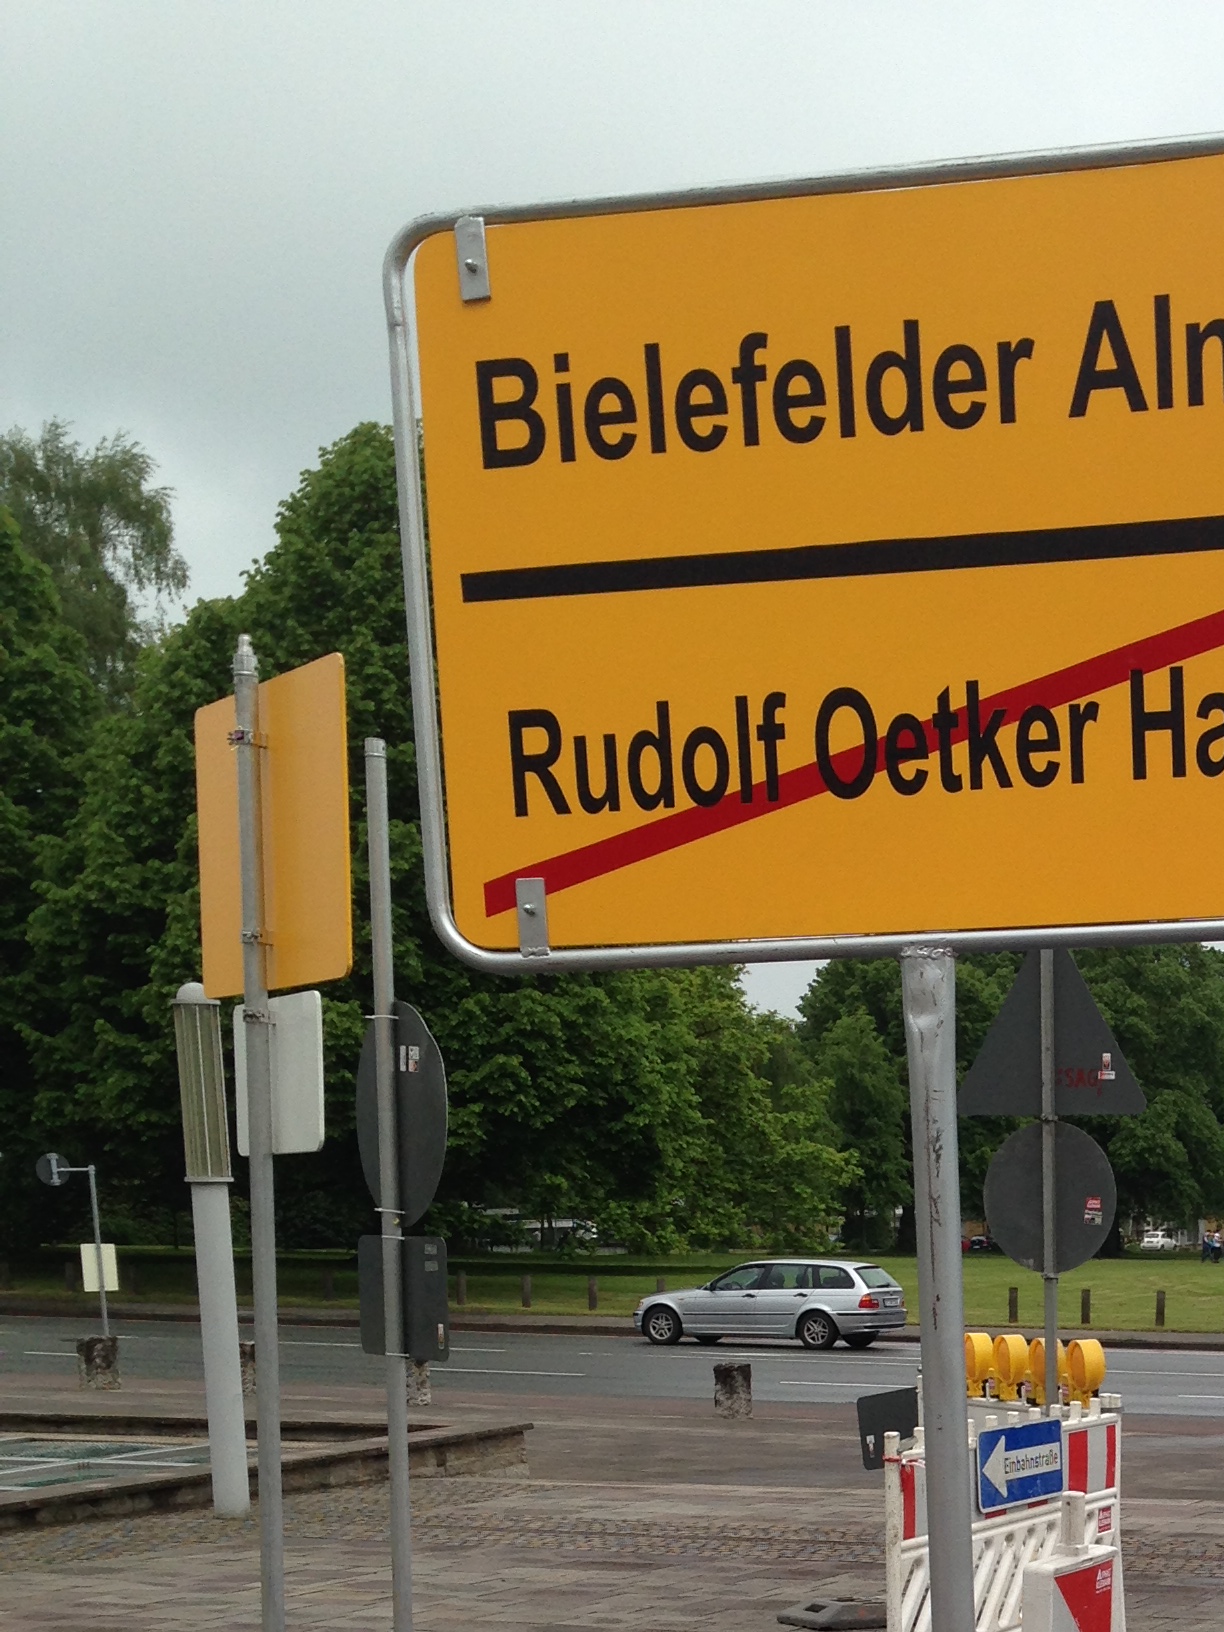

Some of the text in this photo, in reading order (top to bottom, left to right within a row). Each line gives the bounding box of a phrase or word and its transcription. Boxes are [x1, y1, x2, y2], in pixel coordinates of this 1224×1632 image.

[477, 320, 1034, 469] Bielefelder
[509, 692, 785, 817] Rudolf
[816, 681, 1099, 799] Oetker
[1003, 1448, 1059, 1475] Einbahnstraße
